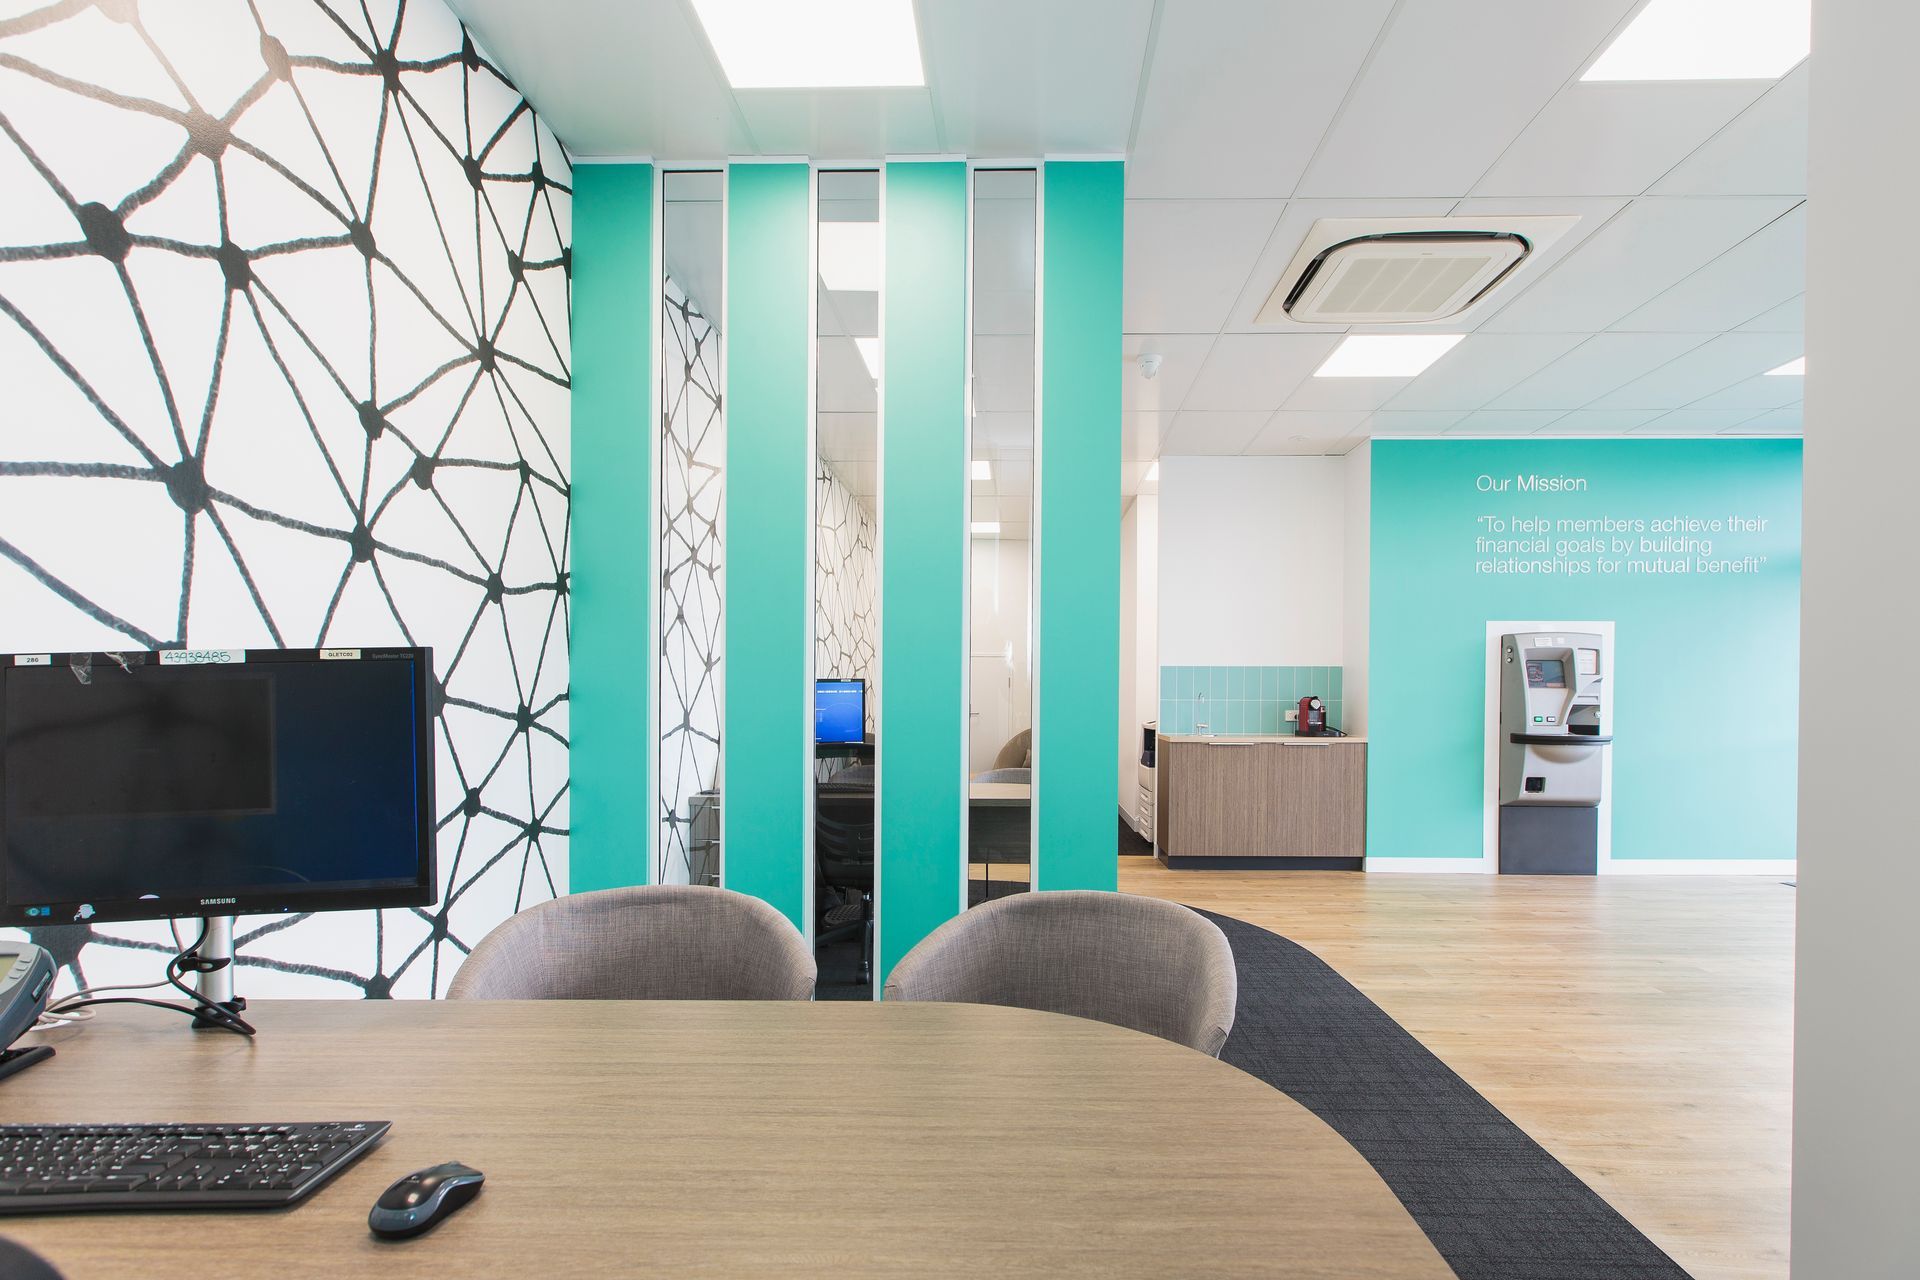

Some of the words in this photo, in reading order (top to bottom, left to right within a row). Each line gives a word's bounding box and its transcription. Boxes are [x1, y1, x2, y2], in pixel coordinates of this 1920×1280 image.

[1476, 474, 1511, 492] Our
[1517, 474, 1588, 492] Mission
[1477, 515, 1505, 533] “To
[1511, 514, 1551, 536] help
[1556, 514, 1645, 533] members
[1649, 514, 1721, 533] achieve
[1727, 514, 1768, 533] their
[1475, 536, 1550, 553] financial
[1555, 536, 1606, 557] goals
[1611, 535, 1634, 557] by
[1640, 535, 1712, 557] building
[1475, 556, 1592, 577] relationships
[1597, 556, 1622, 574] for
[1627, 556, 1690, 574] mutual
[1696, 556, 1767, 574] benefit”
